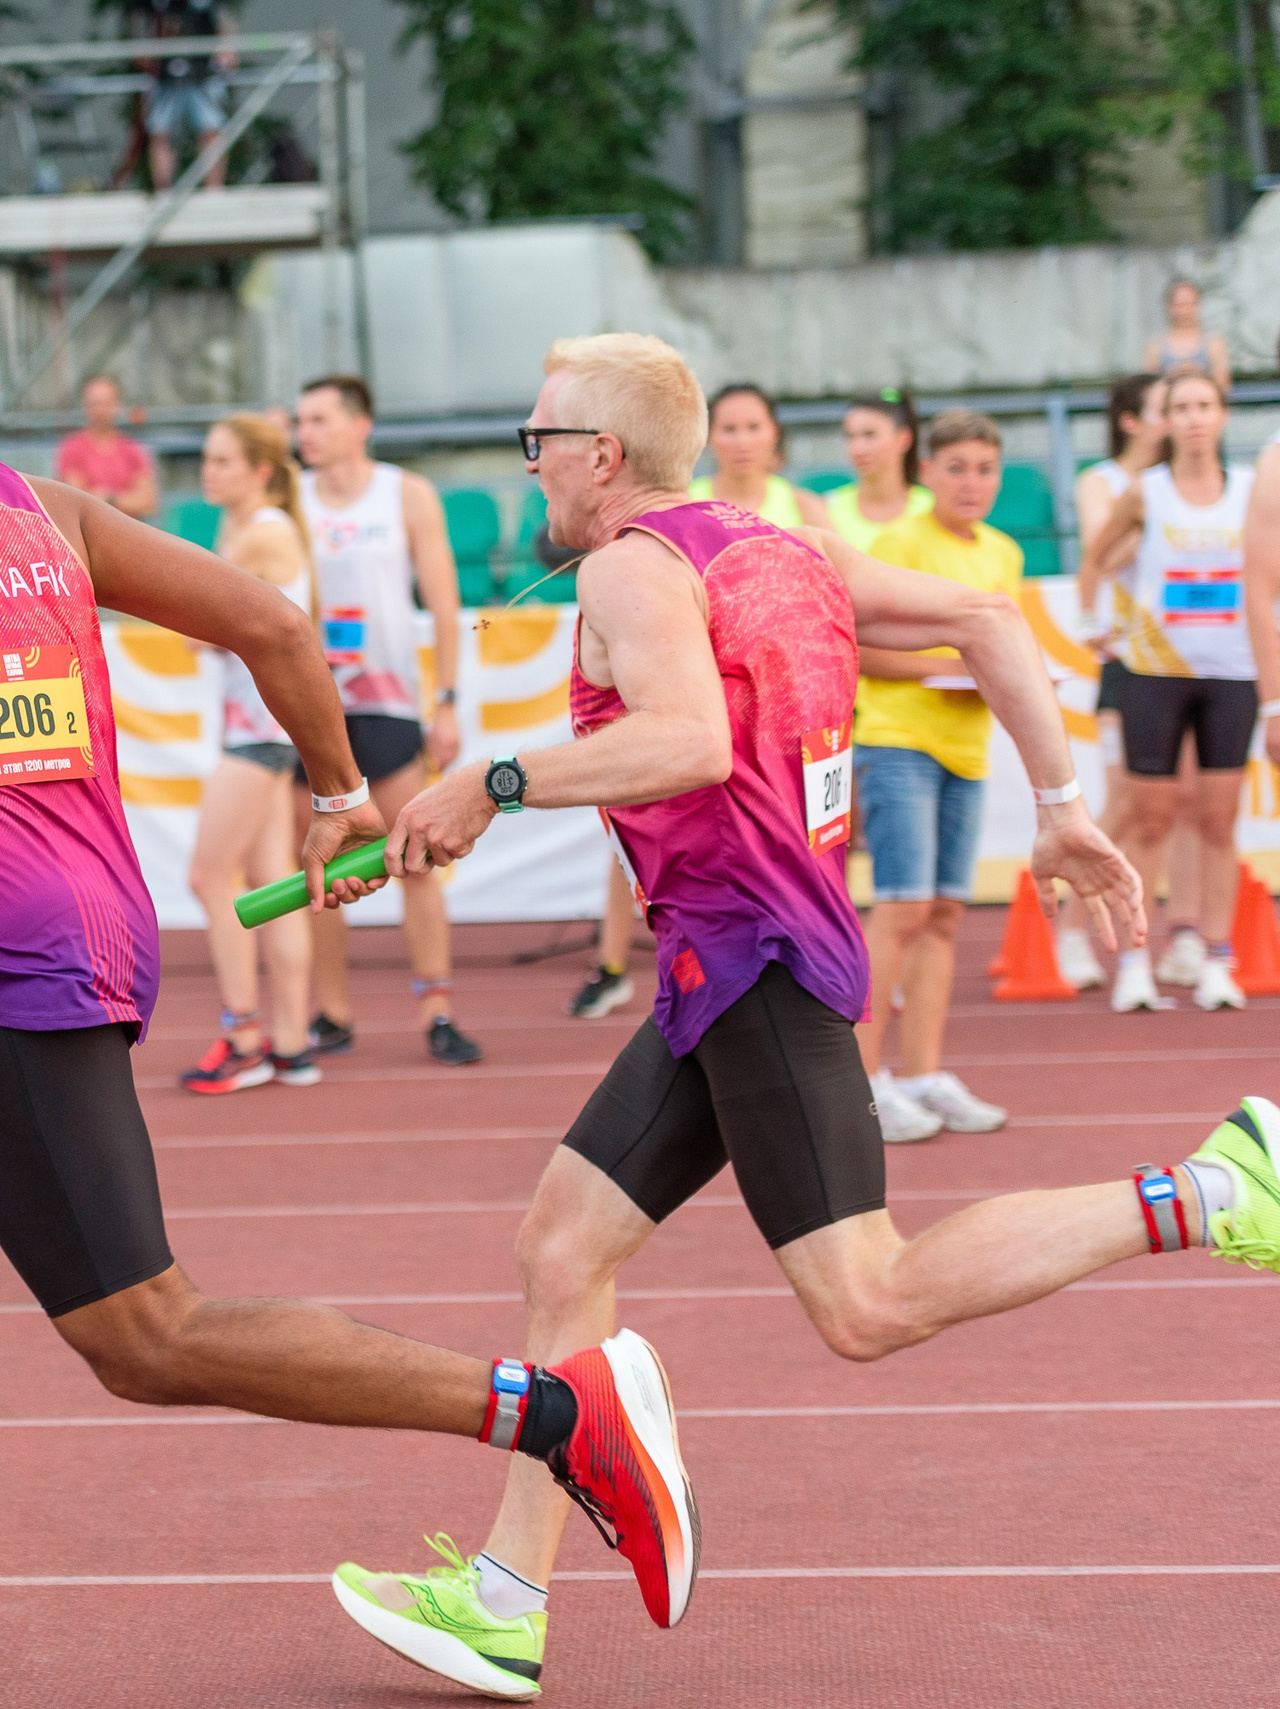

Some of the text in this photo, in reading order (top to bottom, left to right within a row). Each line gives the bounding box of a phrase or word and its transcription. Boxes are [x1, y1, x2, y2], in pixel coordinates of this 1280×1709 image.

[66, 711, 77, 734] 2
[2, 762, 23, 775] этап
[24, 759, 43, 772] 1200
[44, 758, 72, 771] метров
